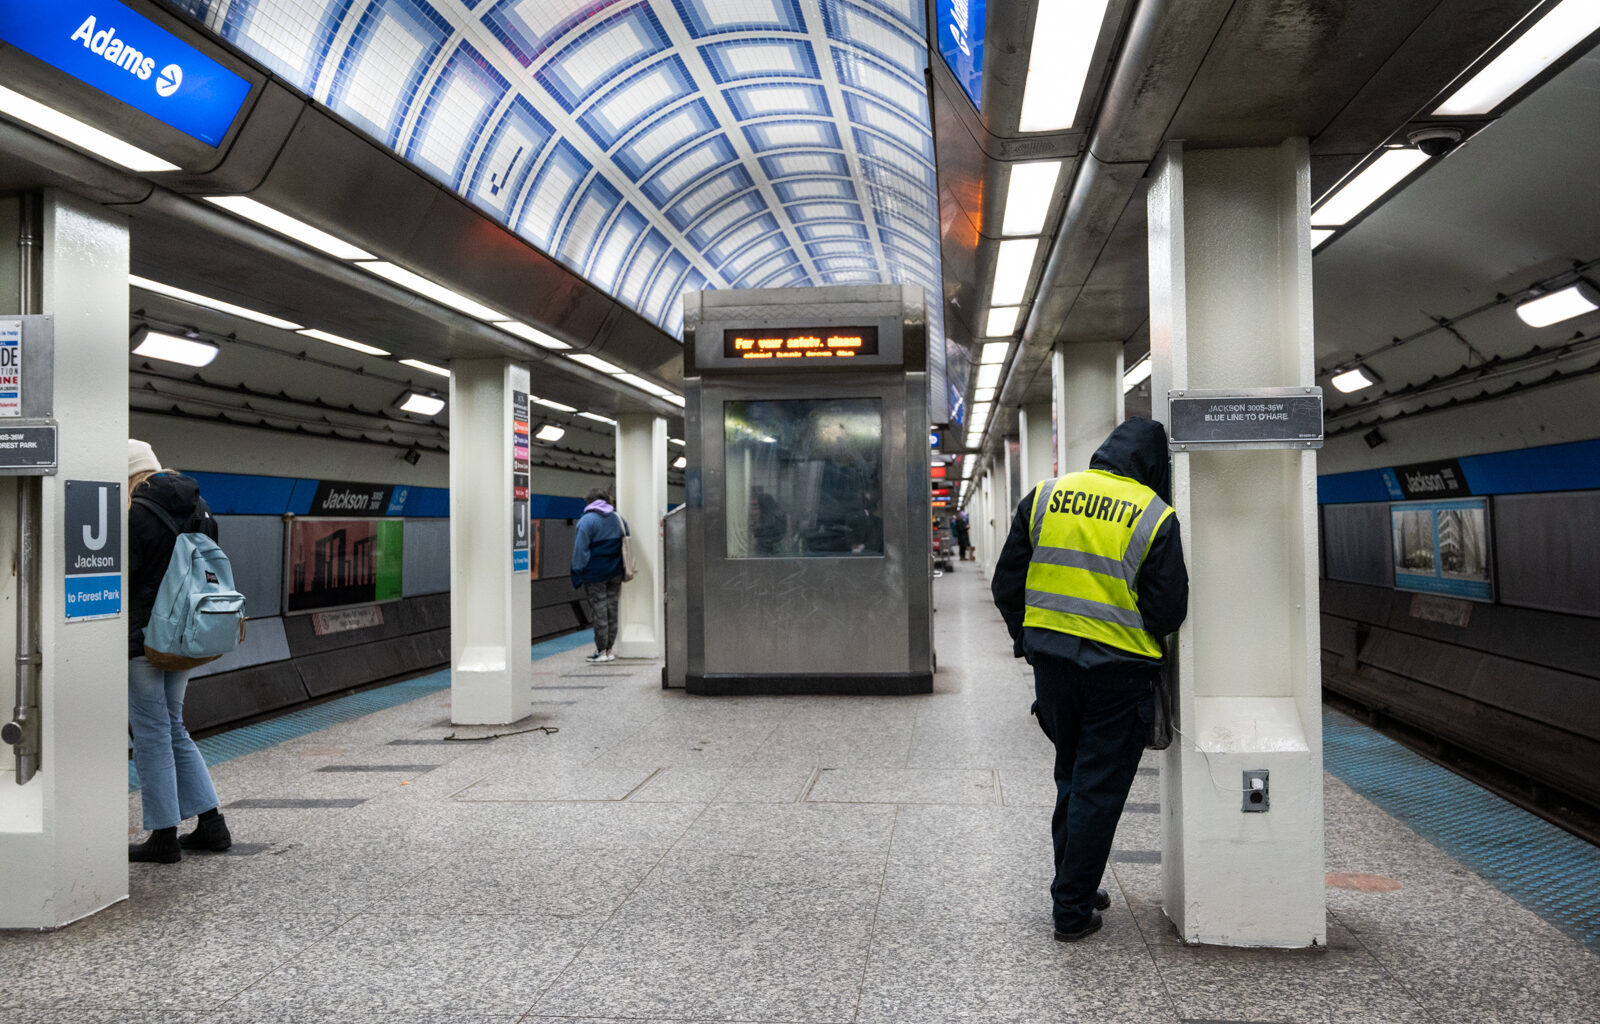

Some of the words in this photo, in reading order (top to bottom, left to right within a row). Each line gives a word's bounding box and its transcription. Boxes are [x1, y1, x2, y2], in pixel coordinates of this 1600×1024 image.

[70, 14, 156, 80] Adams
[1205, 414, 1225, 422] BLUE
[1226, 413, 1244, 421] LINE
[1245, 413, 1257, 421] TO
[1258, 412, 1288, 421] O'HARE
[1208, 404, 1246, 413] JACKSON
[1247, 403, 1284, 413] 300S-36W
[20, 441, 37, 449] PARK
[1404, 470, 1447, 494] Jackson
[321, 488, 370, 511] Jackson
[1049, 489, 1143, 529] SECURITY
[83, 487, 108, 551] J
[517, 504, 525, 538] J
[74, 554, 114, 569] Jackson
[67, 593, 76, 604] to
[77, 590, 102, 603] Forest
[103, 588, 120, 600] Park
